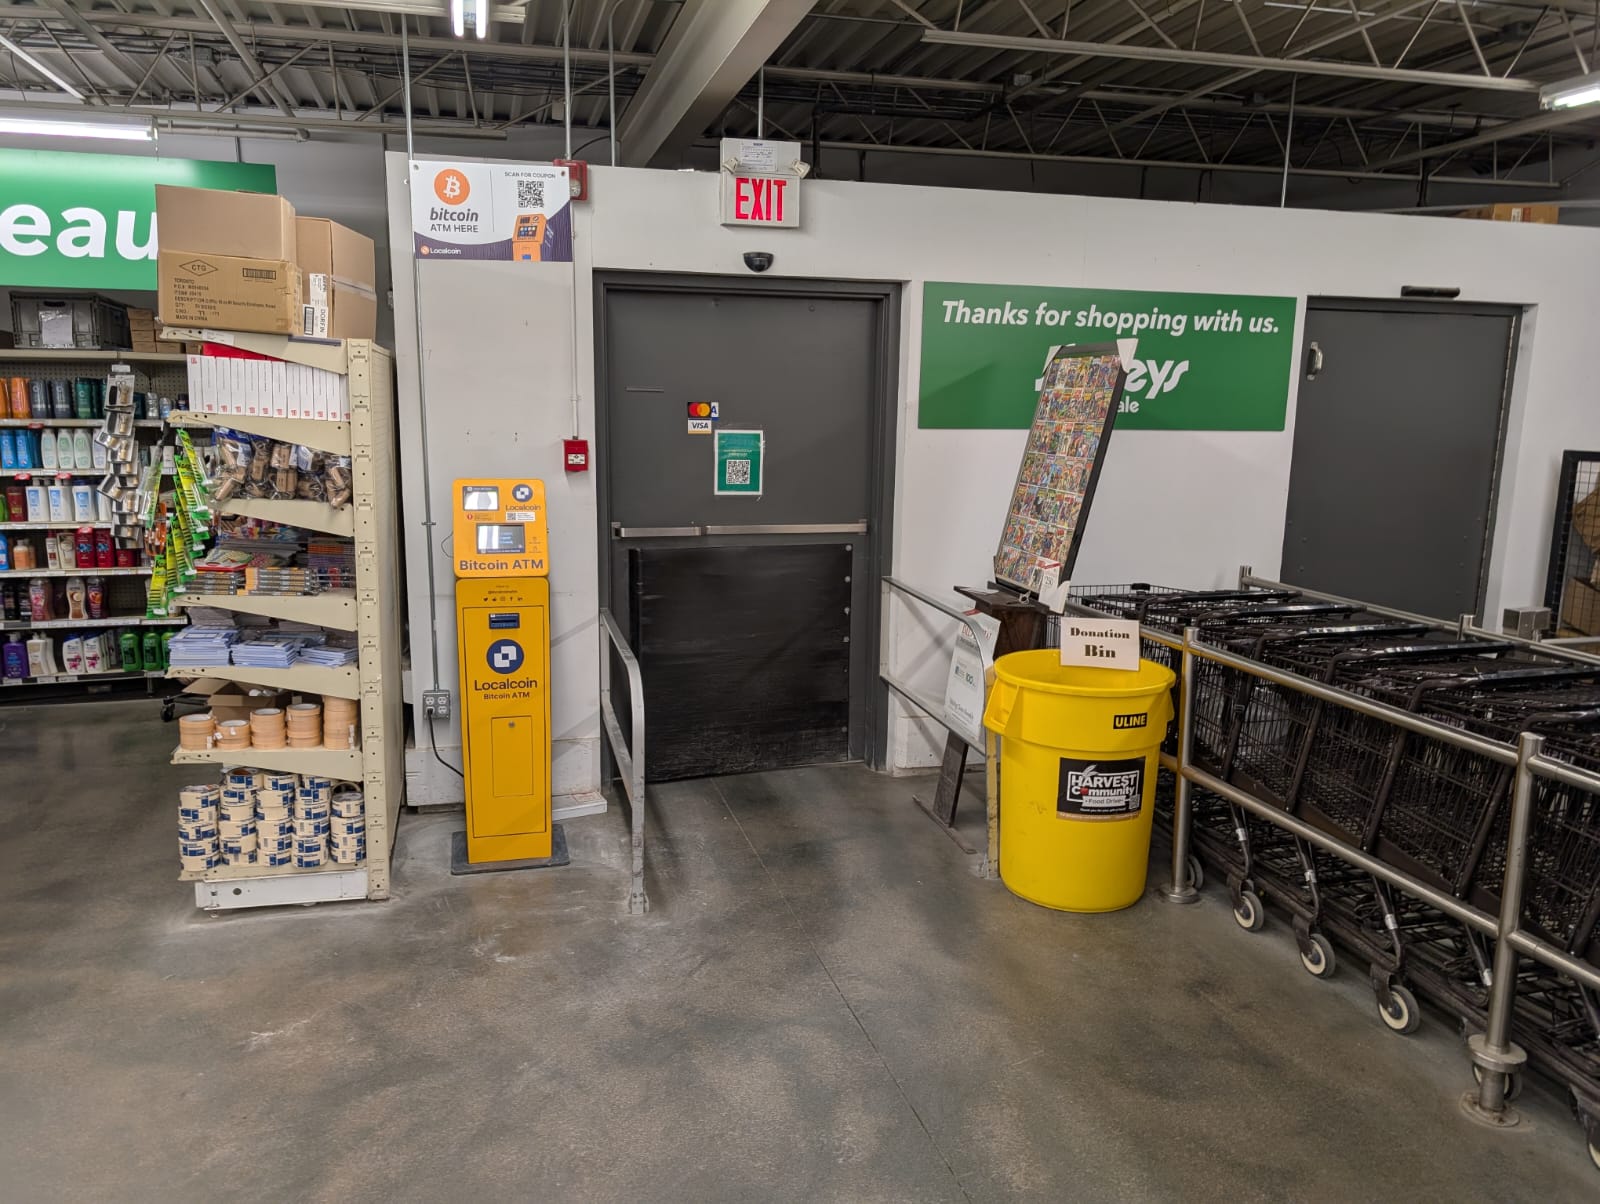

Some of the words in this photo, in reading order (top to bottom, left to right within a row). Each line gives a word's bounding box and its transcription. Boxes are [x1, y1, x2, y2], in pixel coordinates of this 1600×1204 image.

[735, 177, 787, 222] EXIT
[430, 207, 479, 222] bitcoin
[430, 223, 452, 233] ATM
[454, 224, 479, 233] HERE
[429, 247, 462, 255] Localcoin
[942, 299, 1029, 325] Thanks
[1035, 302, 1071, 326] for
[1074, 304, 1188, 337] shopping
[1193, 309, 1242, 332] with
[1248, 316, 1279, 333] us.
[691, 422, 709, 430] VISA
[505, 503, 541, 511] Localcoin
[459, 559, 508, 571] Bitcoin
[512, 559, 543, 570] ATM
[1070, 626, 1131, 639] Donation
[1084, 644, 1117, 658] Bin
[474, 677, 538, 691] Localcoin
[483, 692, 510, 700] Bitcoin
[511, 691, 530, 699] ATM
[1115, 713, 1146, 728] ULINE
[1071, 773, 1137, 788] HARVEST
